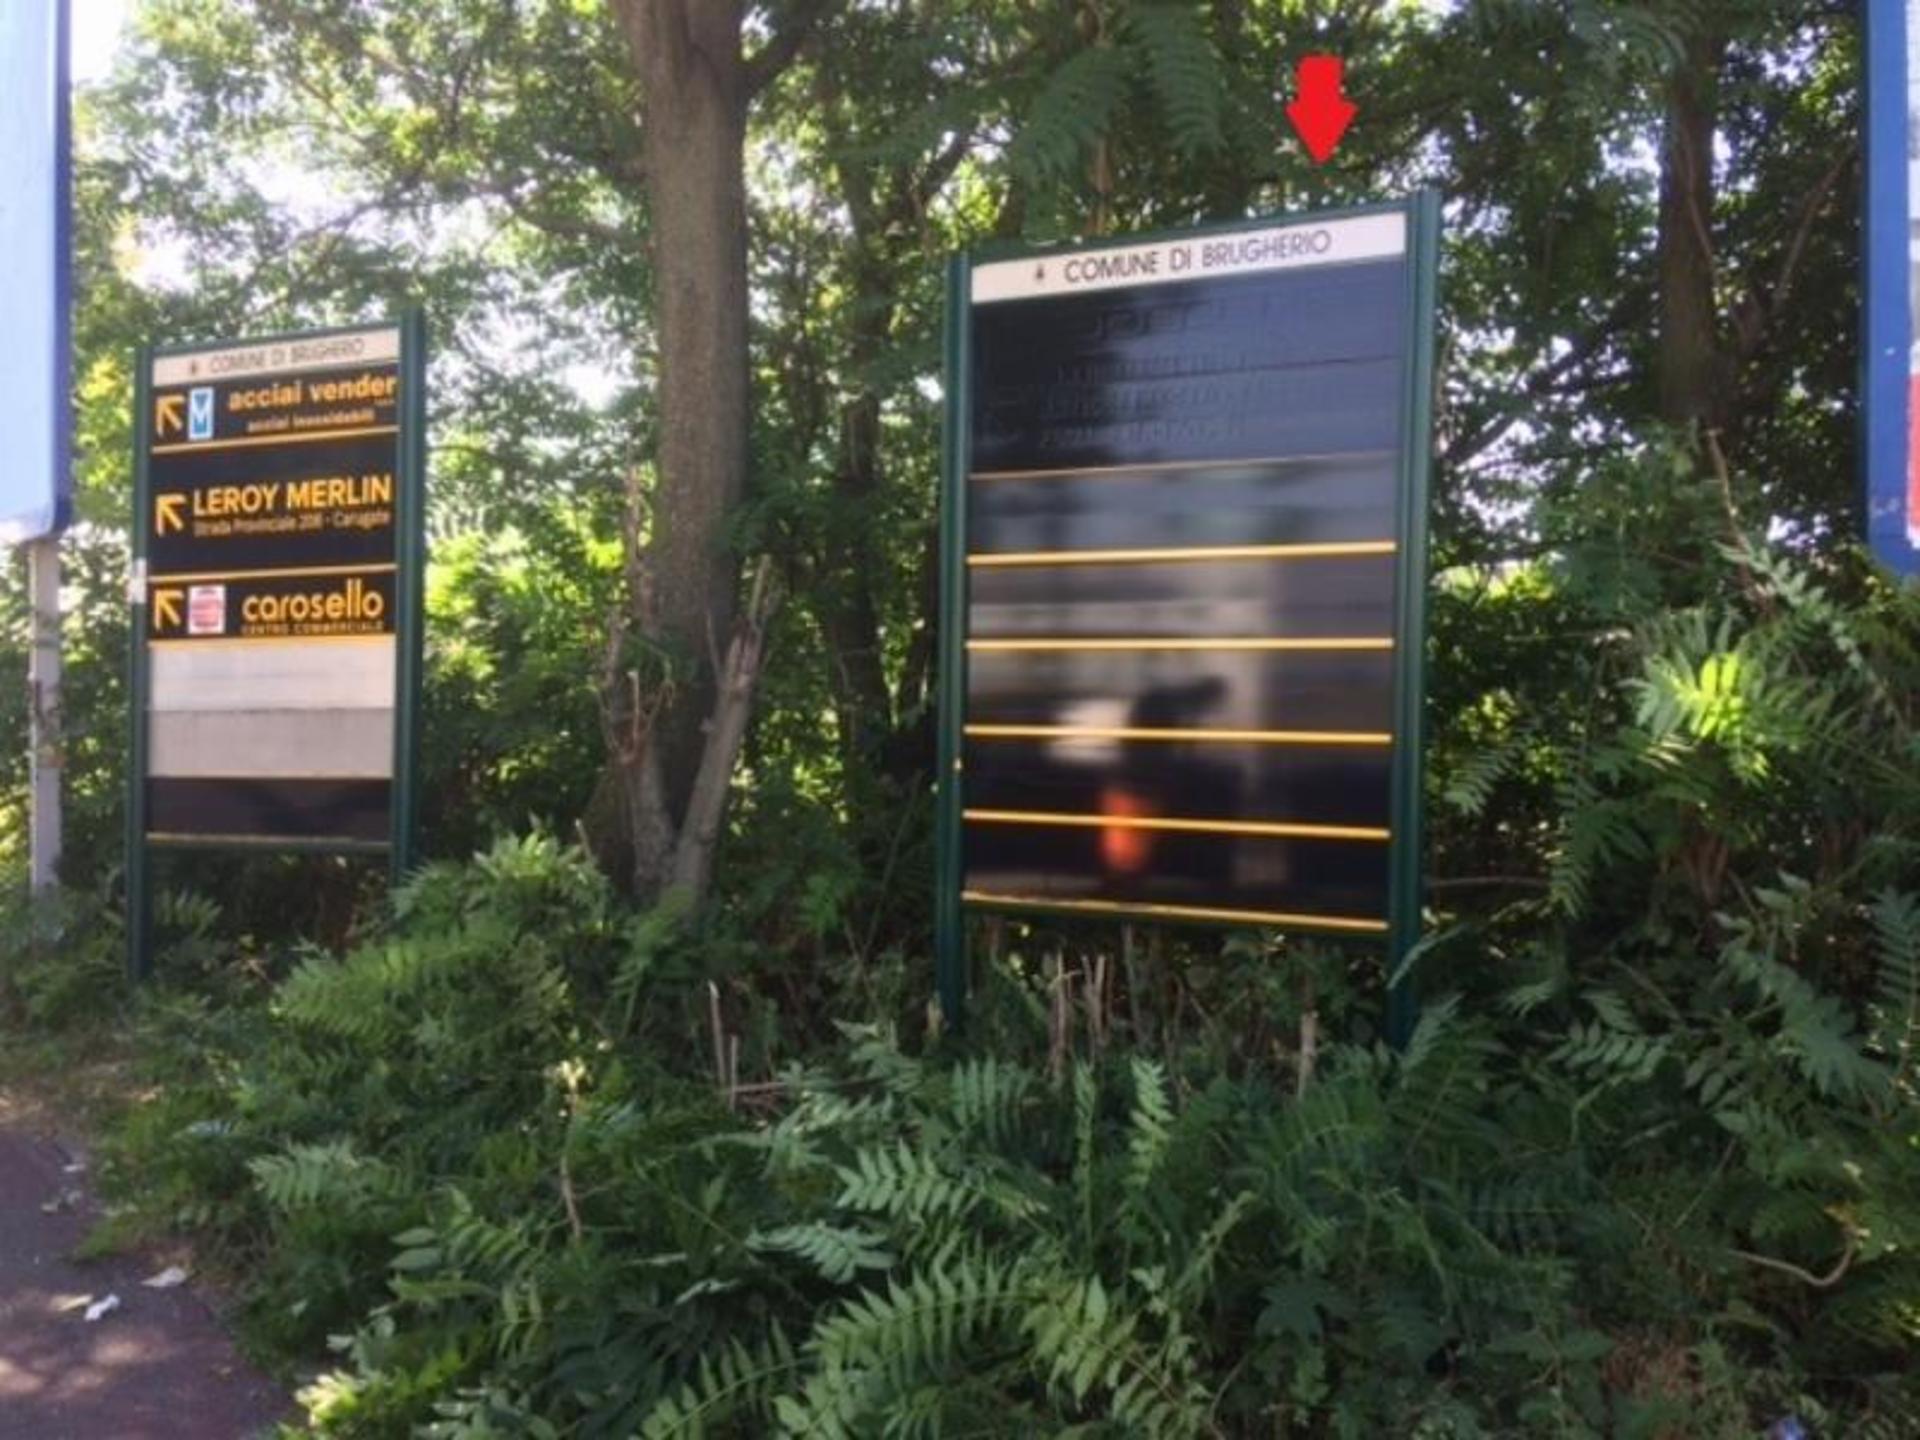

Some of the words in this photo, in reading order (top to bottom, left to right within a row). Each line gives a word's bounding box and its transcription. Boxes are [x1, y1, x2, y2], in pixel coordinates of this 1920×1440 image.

[1064, 251, 1159, 283] COMUNE
[1170, 247, 1191, 271] DI
[1202, 229, 1332, 269] BRUGHERIO
[210, 353, 265, 374] COMUNE
[270, 348, 285, 364] DI
[309, 373, 397, 402] vender
[193, 482, 279, 516] LEROY
[286, 475, 392, 509] MERLIN
[242, 578, 384, 622] carosello
